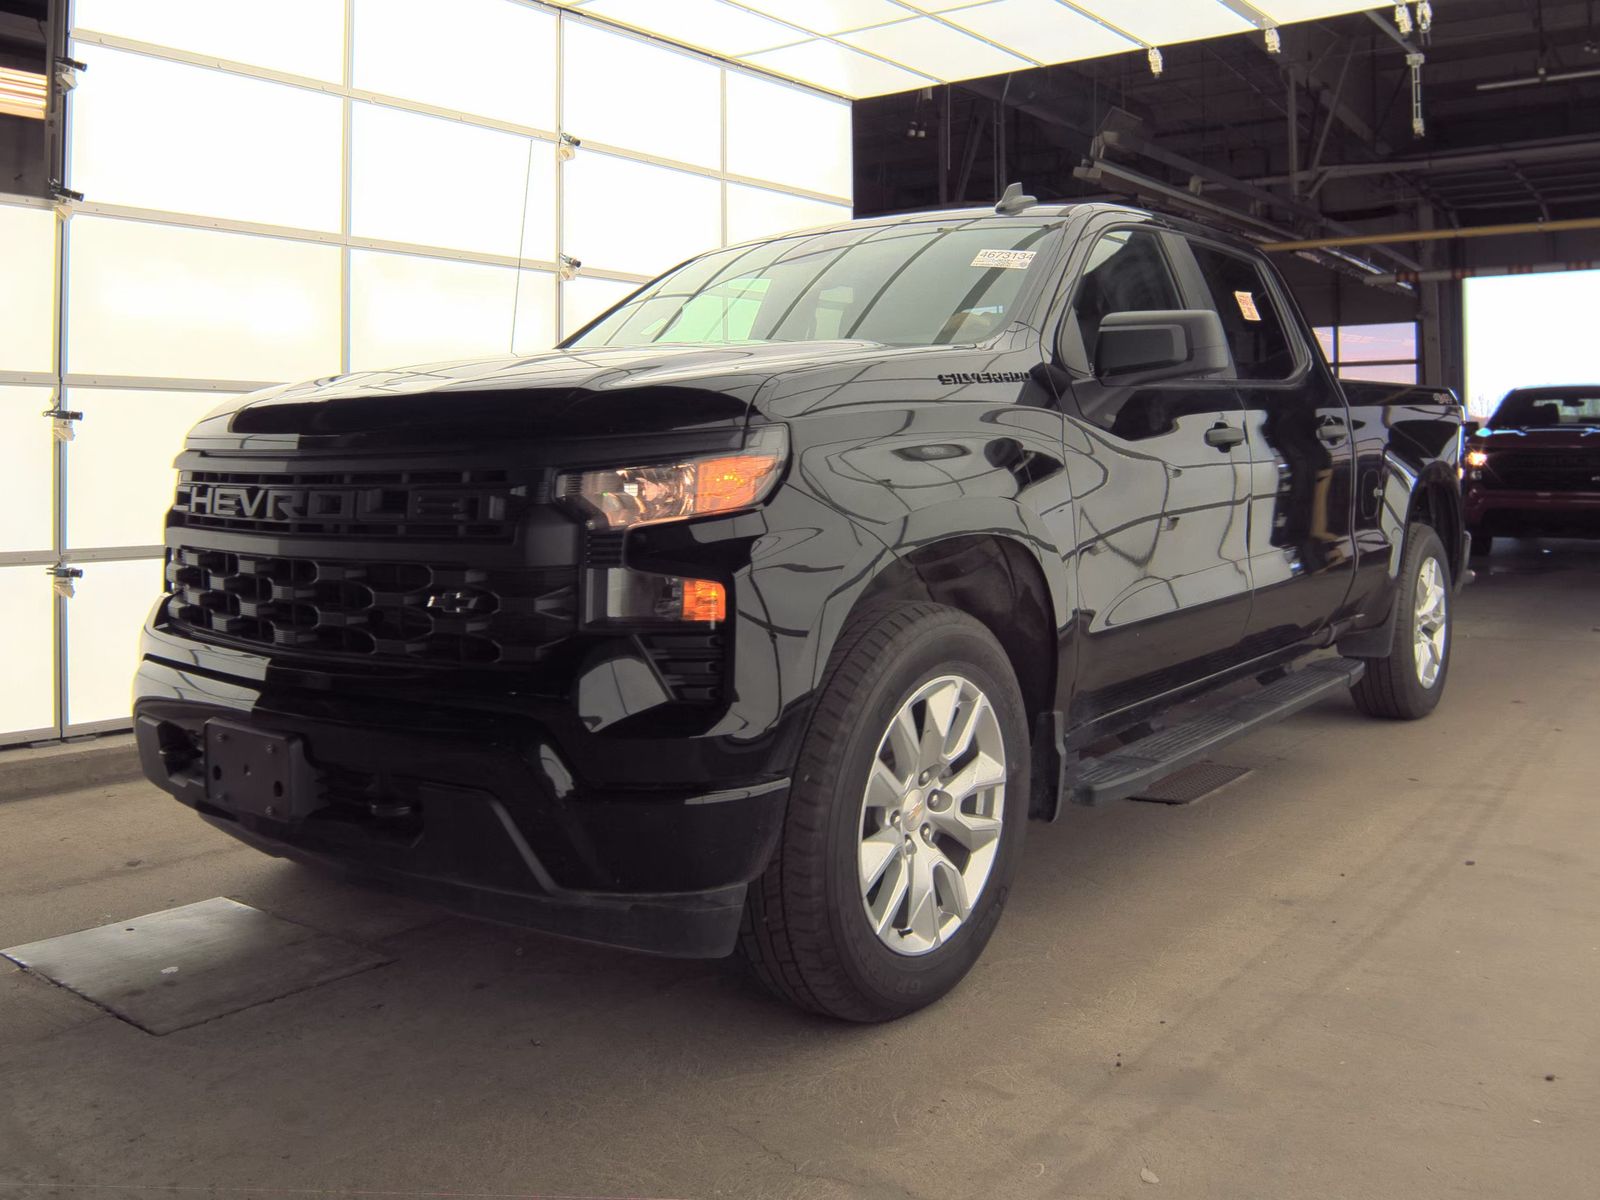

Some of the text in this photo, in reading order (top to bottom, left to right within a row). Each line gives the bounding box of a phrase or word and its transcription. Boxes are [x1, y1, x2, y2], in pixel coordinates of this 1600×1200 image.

[979, 251, 1034, 260] 4673134
[937, 372, 1031, 385] SILVERADO
[172, 485, 527, 521] CHEVROLET
